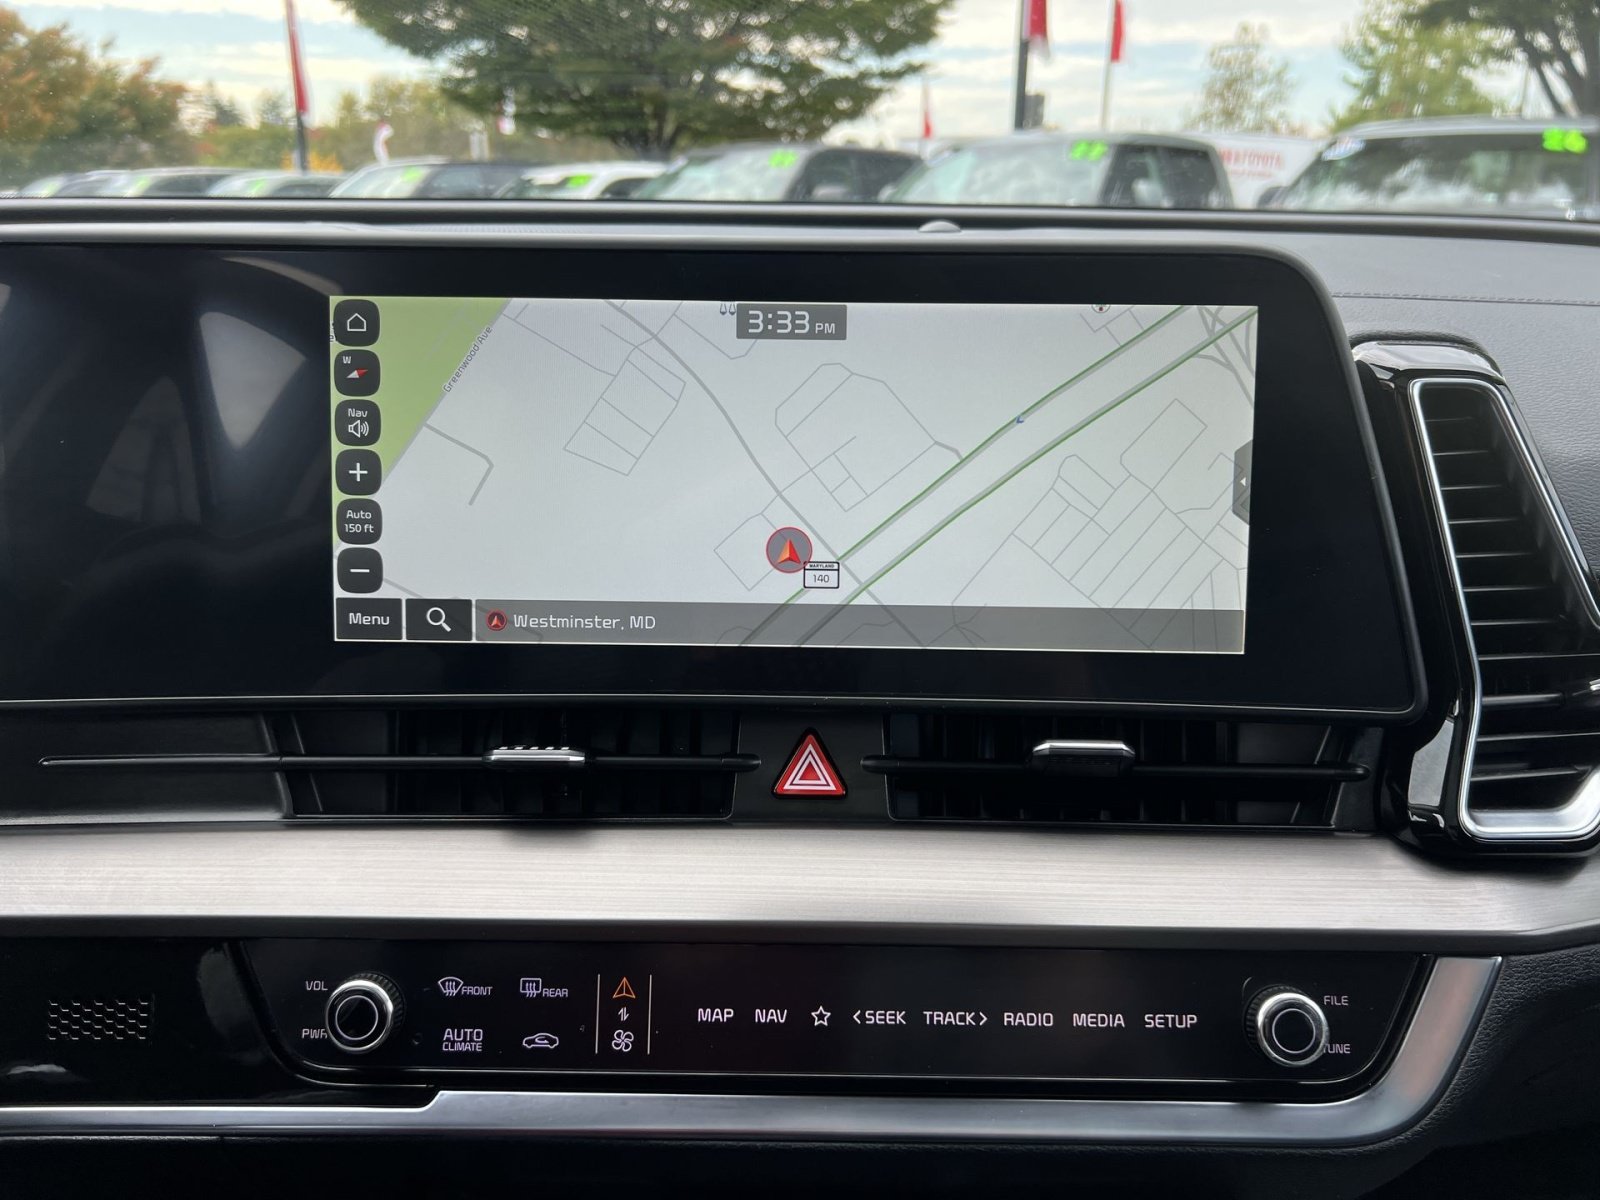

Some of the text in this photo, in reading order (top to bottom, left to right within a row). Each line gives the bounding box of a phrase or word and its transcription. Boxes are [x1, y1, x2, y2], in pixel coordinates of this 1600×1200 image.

[748, 310, 836, 334] 3:33 PM
[342, 355, 352, 365] W
[443, 326, 493, 393] Greenwood Ave
[347, 408, 368, 418] Nav
[346, 509, 372, 520] Auto
[344, 523, 374, 533] 150 ft
[812, 574, 830, 583] 140
[349, 613, 390, 626] Menu
[513, 614, 656, 630] Westminster, MD
[305, 980, 328, 991] VOL
[461, 985, 493, 996] FRONT
[542, 987, 569, 998] REAR
[1323, 995, 1349, 1006] FILE
[697, 1008, 734, 1022] MAP
[755, 1009, 787, 1023] NAV
[1003, 1012, 1054, 1027] RADIO
[1072, 1013, 1126, 1028] MEDIA
[1144, 1014, 1198, 1028] SETUP
[301, 1028, 328, 1039] PWR
[443, 1028, 484, 1042] AUTO
[442, 1042, 483, 1052] CLIMATE
